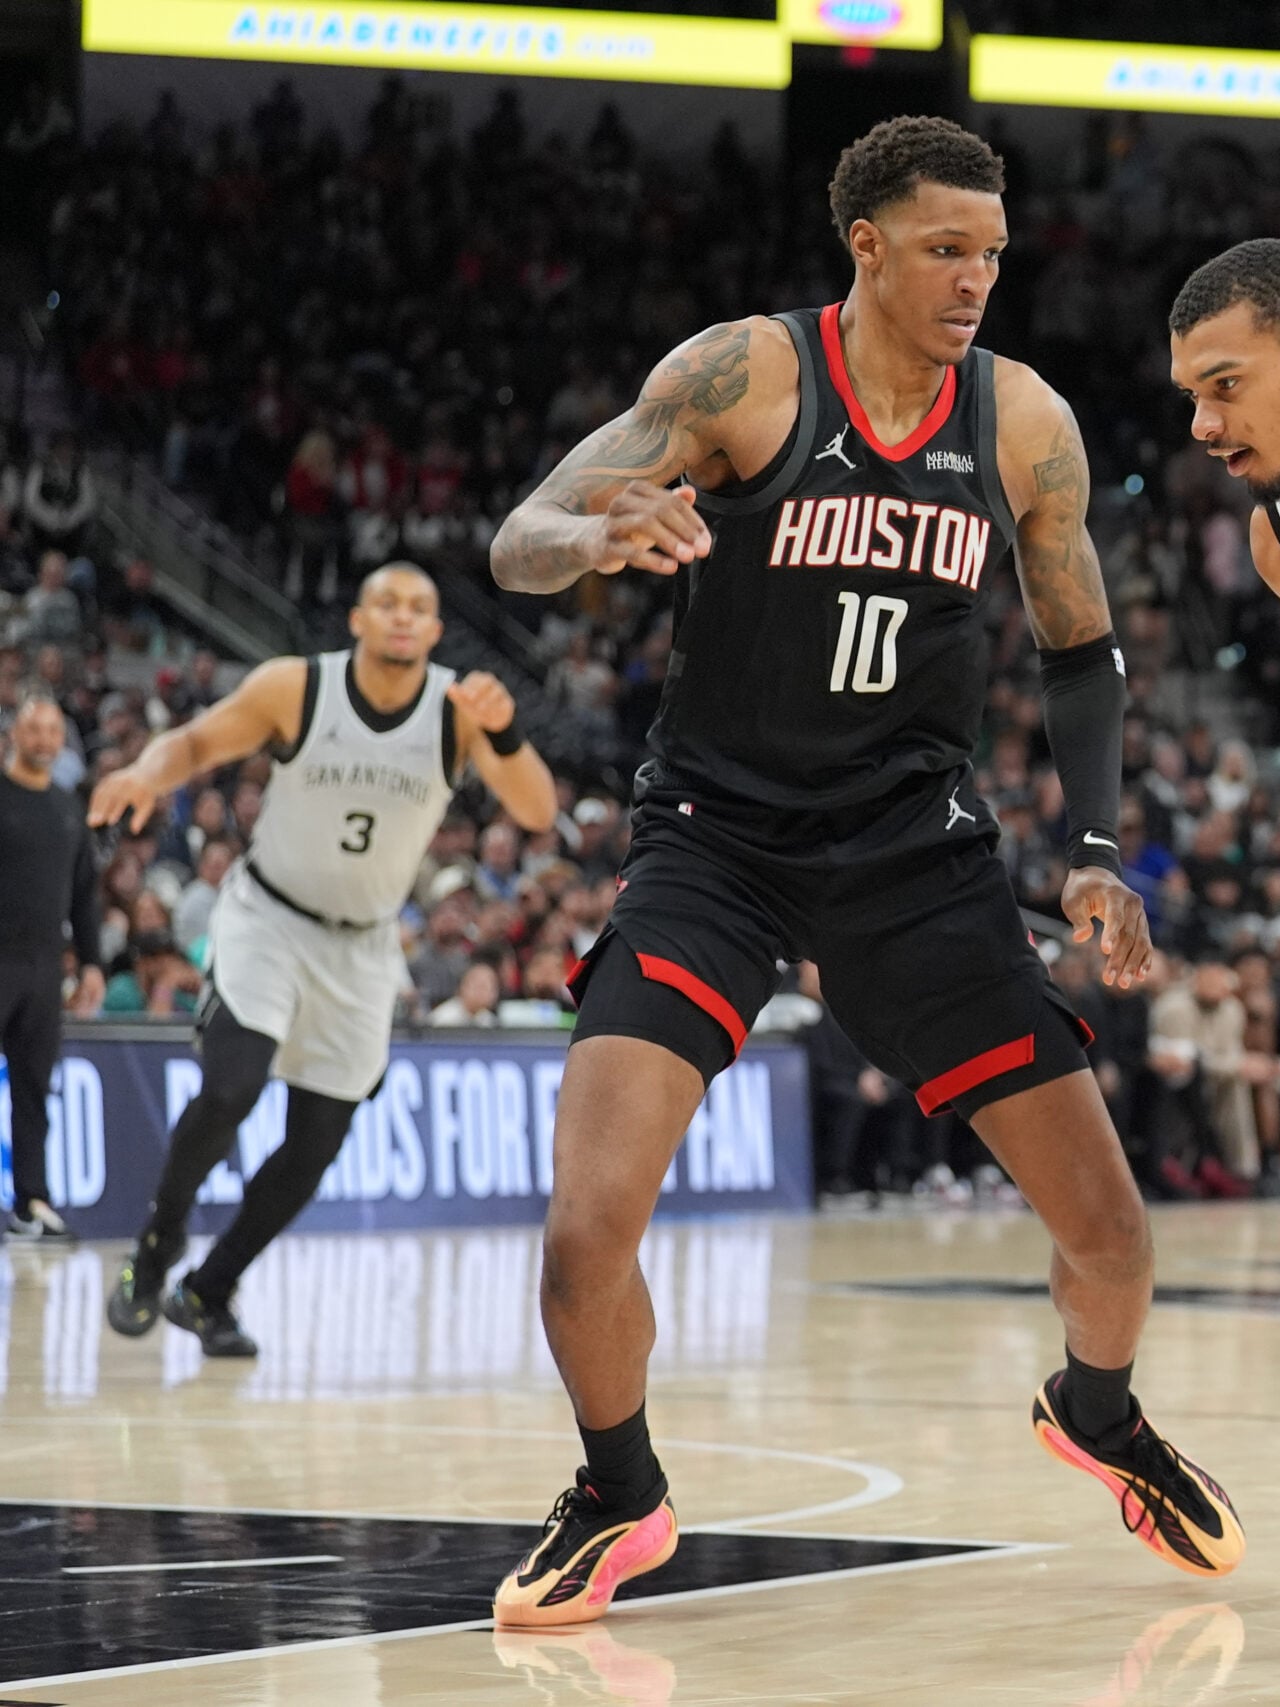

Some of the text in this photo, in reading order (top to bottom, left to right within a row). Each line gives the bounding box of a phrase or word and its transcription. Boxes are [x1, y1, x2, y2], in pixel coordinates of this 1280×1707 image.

[768, 493, 990, 592] HOUSTON
[829, 591, 909, 693] 10
[338, 811, 377, 854] 3
[429, 1059, 533, 1200] FOR
